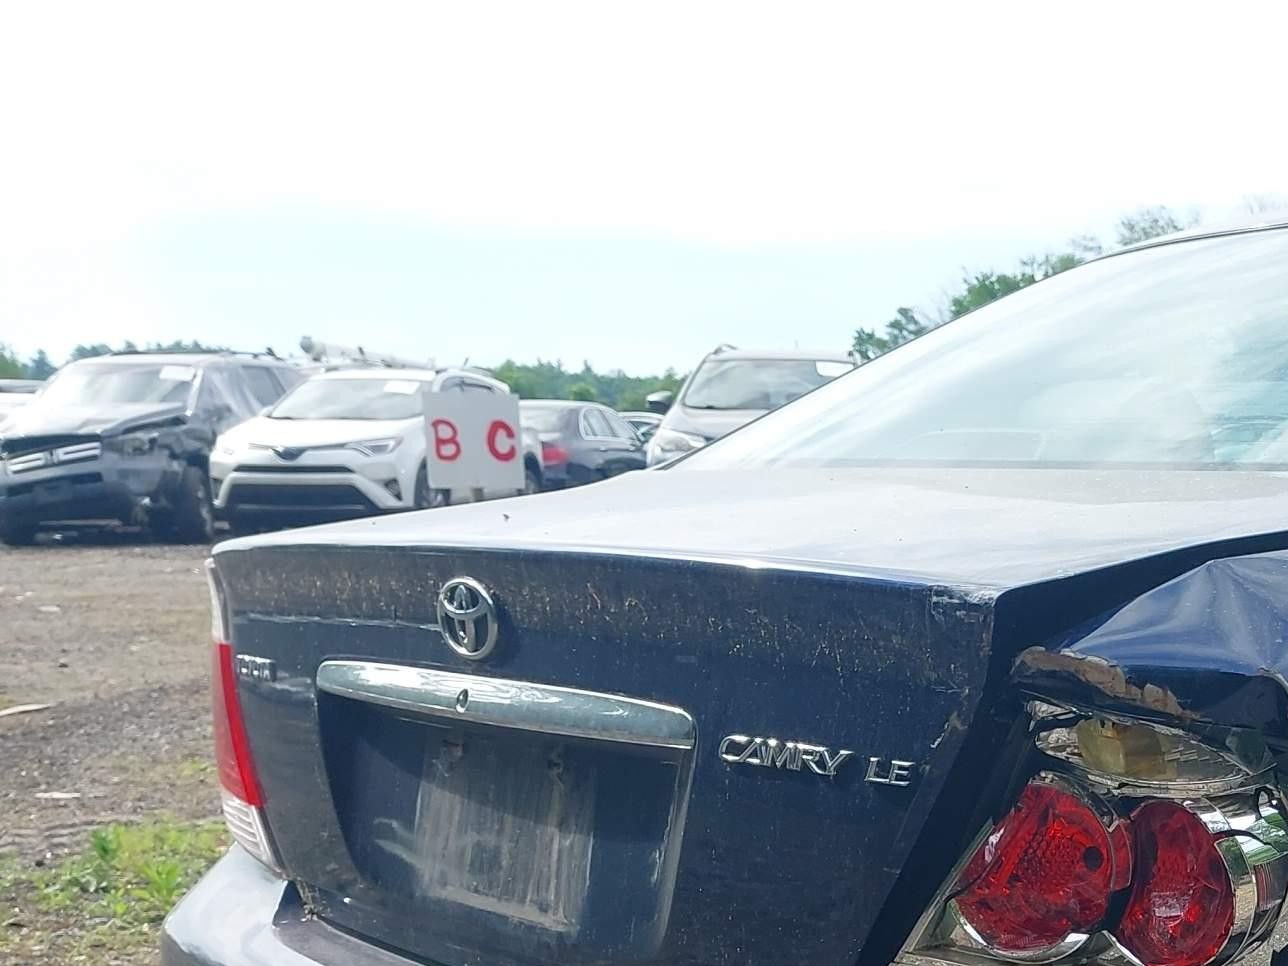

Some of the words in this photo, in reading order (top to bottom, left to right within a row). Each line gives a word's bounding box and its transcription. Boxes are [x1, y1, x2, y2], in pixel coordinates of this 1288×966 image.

[431, 418, 462, 461] B
[487, 420, 517, 462] C
[719, 734, 853, 775] CAMRY
[864, 756, 915, 787] LE
